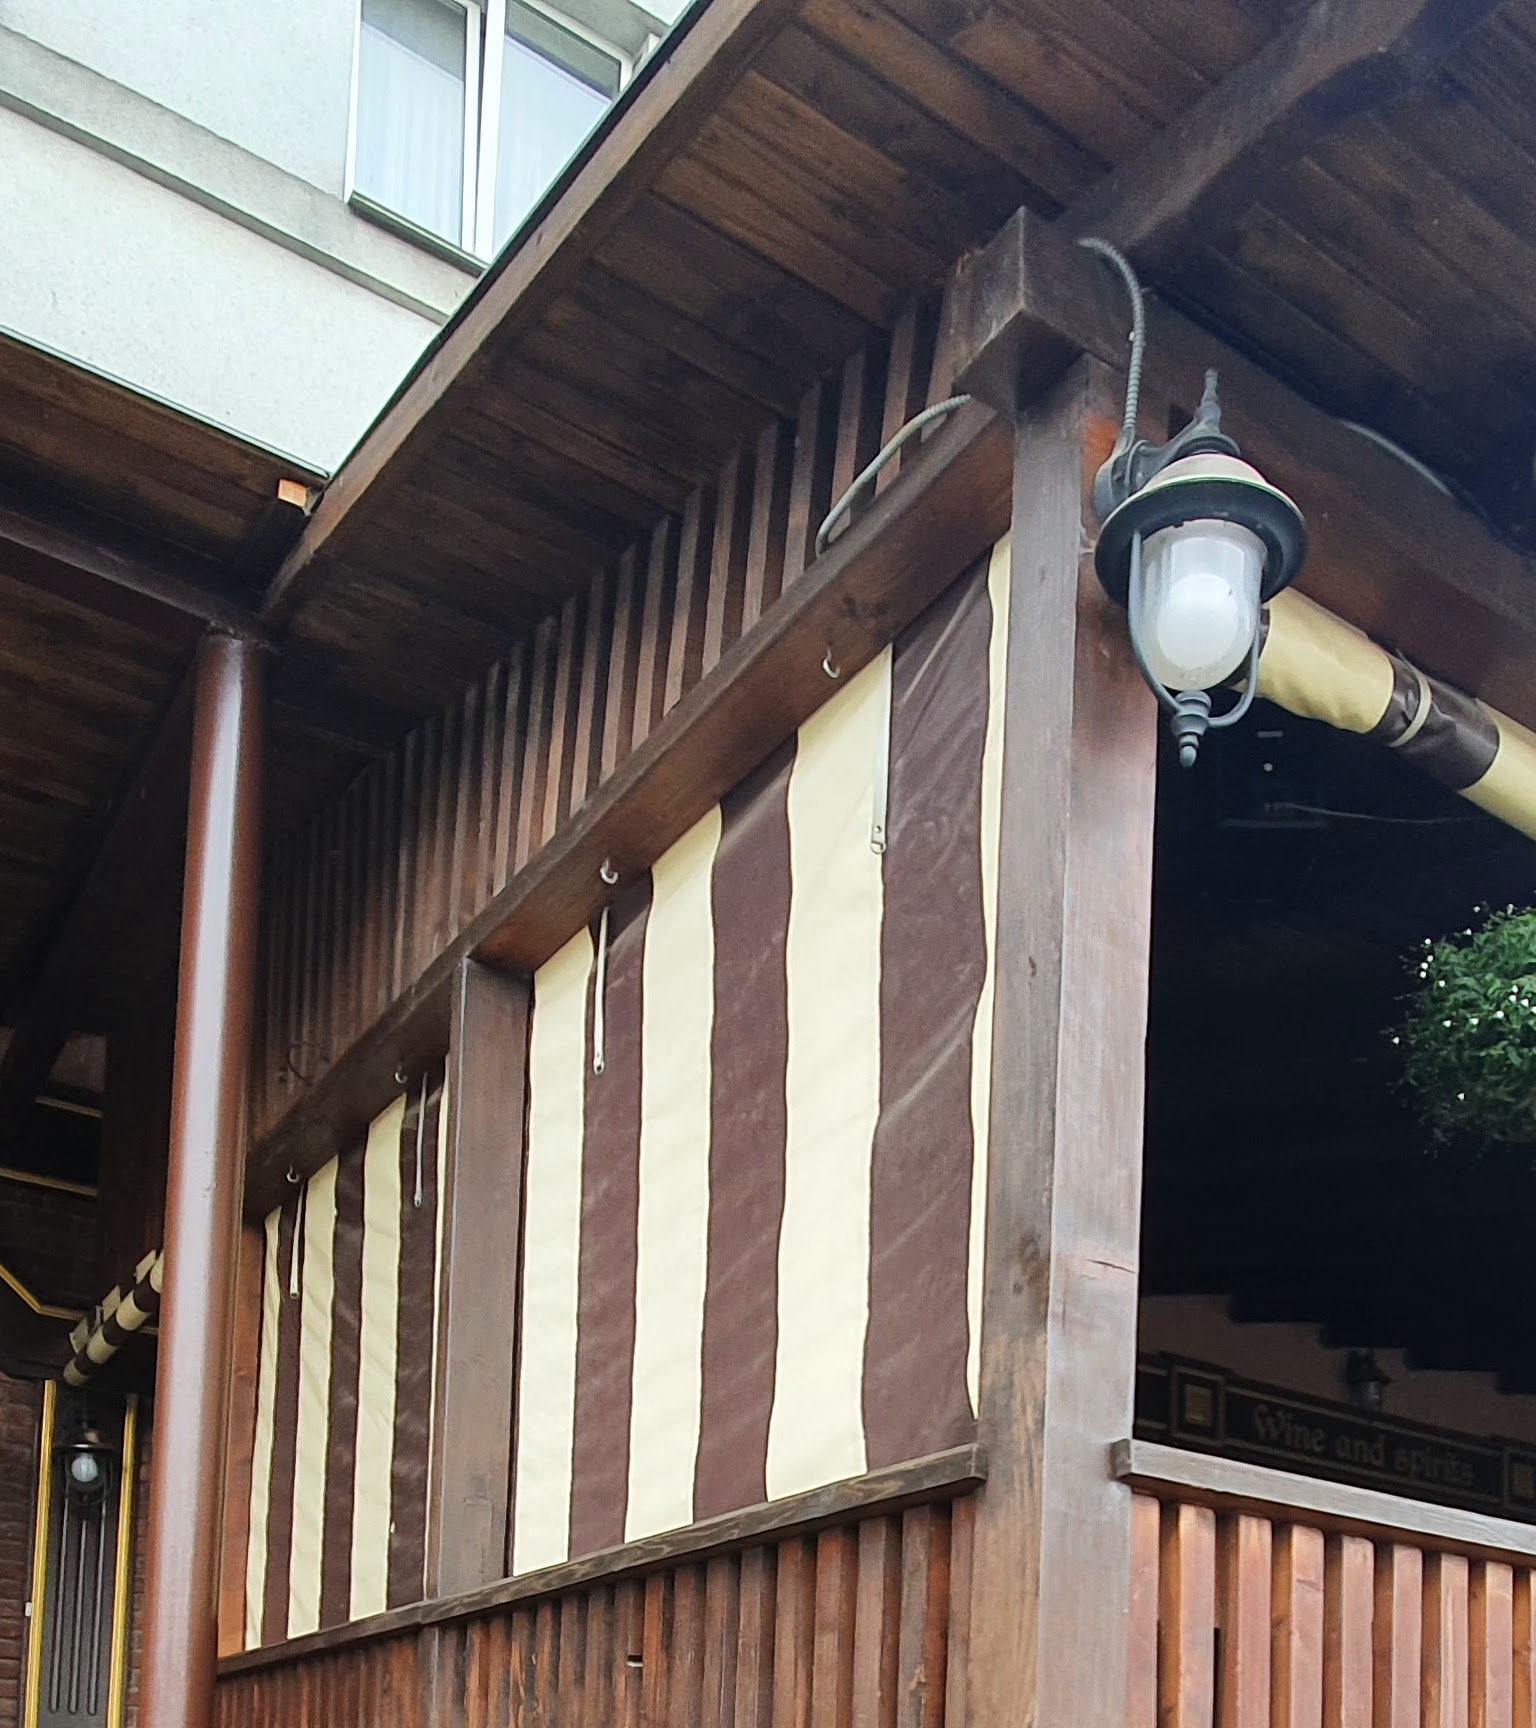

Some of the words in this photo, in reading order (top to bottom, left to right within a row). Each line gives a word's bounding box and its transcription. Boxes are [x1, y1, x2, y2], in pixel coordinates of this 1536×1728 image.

[1253, 1403, 1327, 1453] Wine
[1335, 1432, 1386, 1466] and
[1395, 1446, 1474, 1487] spirits
